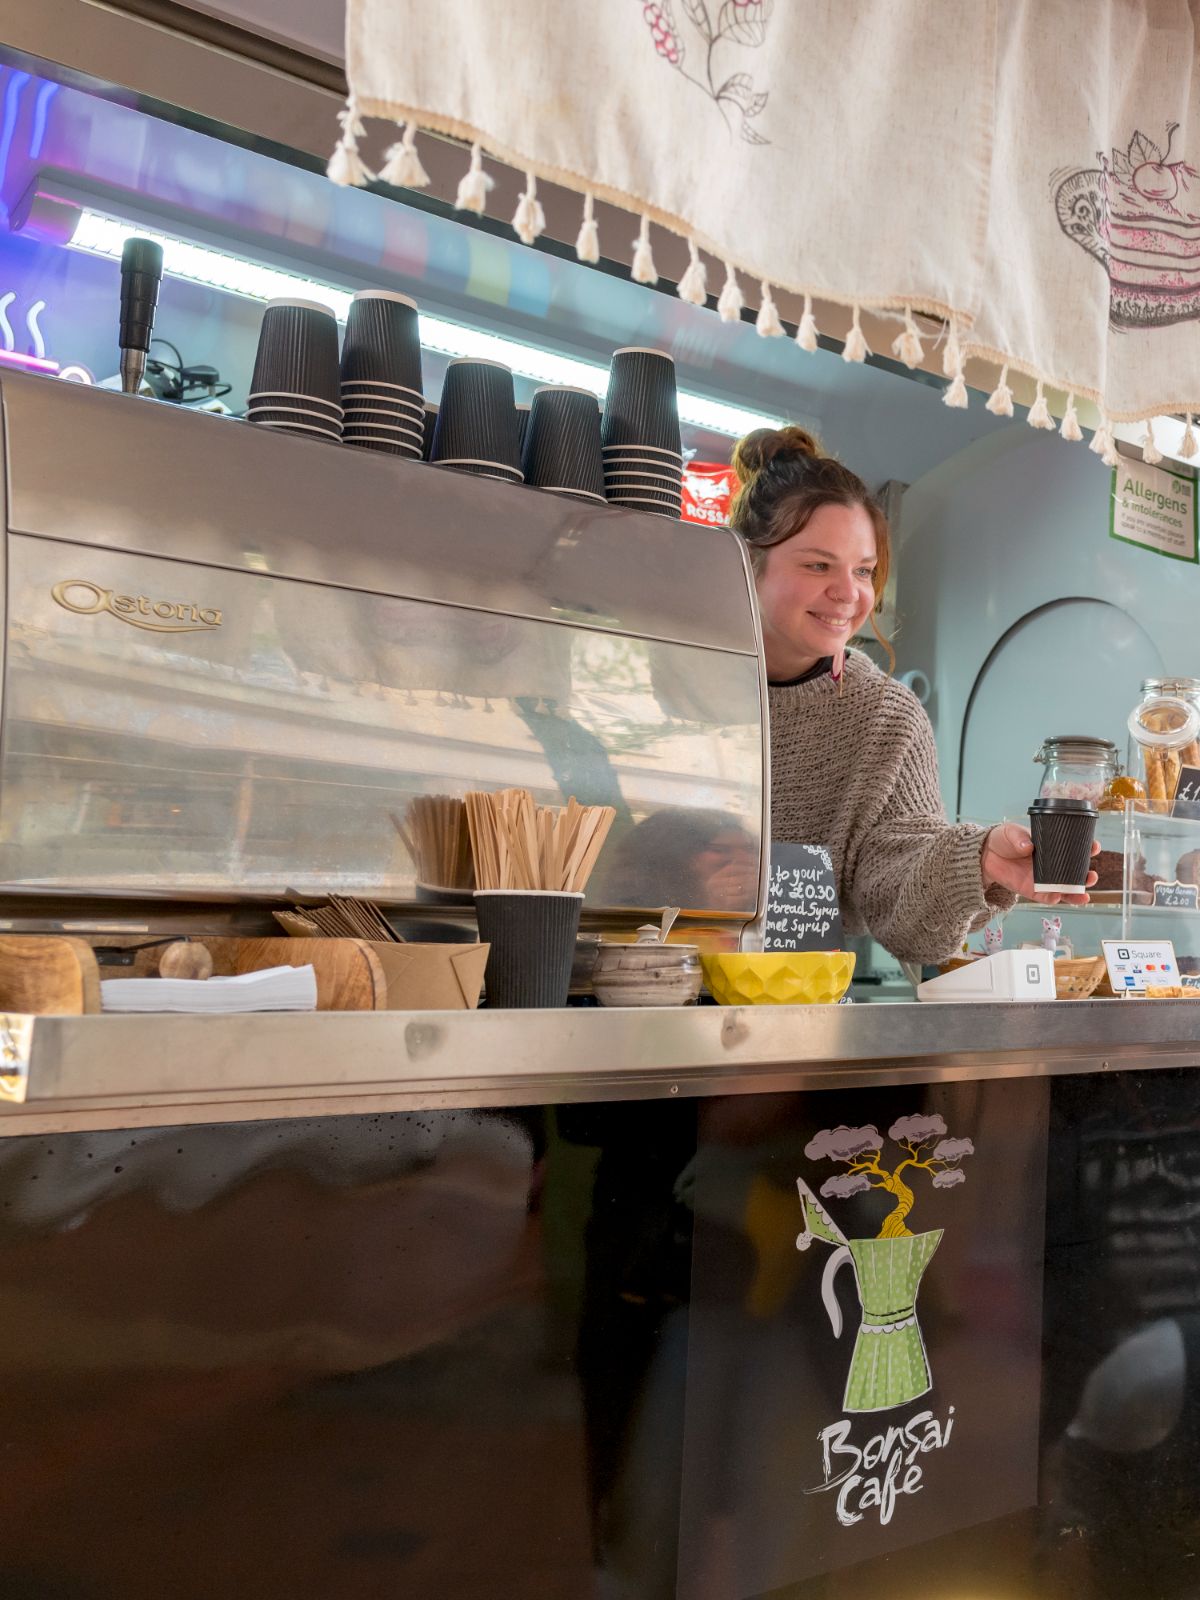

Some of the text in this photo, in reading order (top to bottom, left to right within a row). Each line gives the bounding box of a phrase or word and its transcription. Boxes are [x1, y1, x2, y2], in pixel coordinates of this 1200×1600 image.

[1123, 478, 1188, 515] Allergens
[1122, 499, 1183, 528] & intolerances
[51, 579, 223, 633] Astoria
[776, 865, 790, 882] to
[789, 882, 836, 901] £0.30
[767, 901, 840, 920] rbread Syrup
[790, 918, 830, 939] Syrup
[765, 937, 797, 949] eam
[1131, 950, 1162, 959] Square
[803, 1406, 956, 1494] Bonsai
